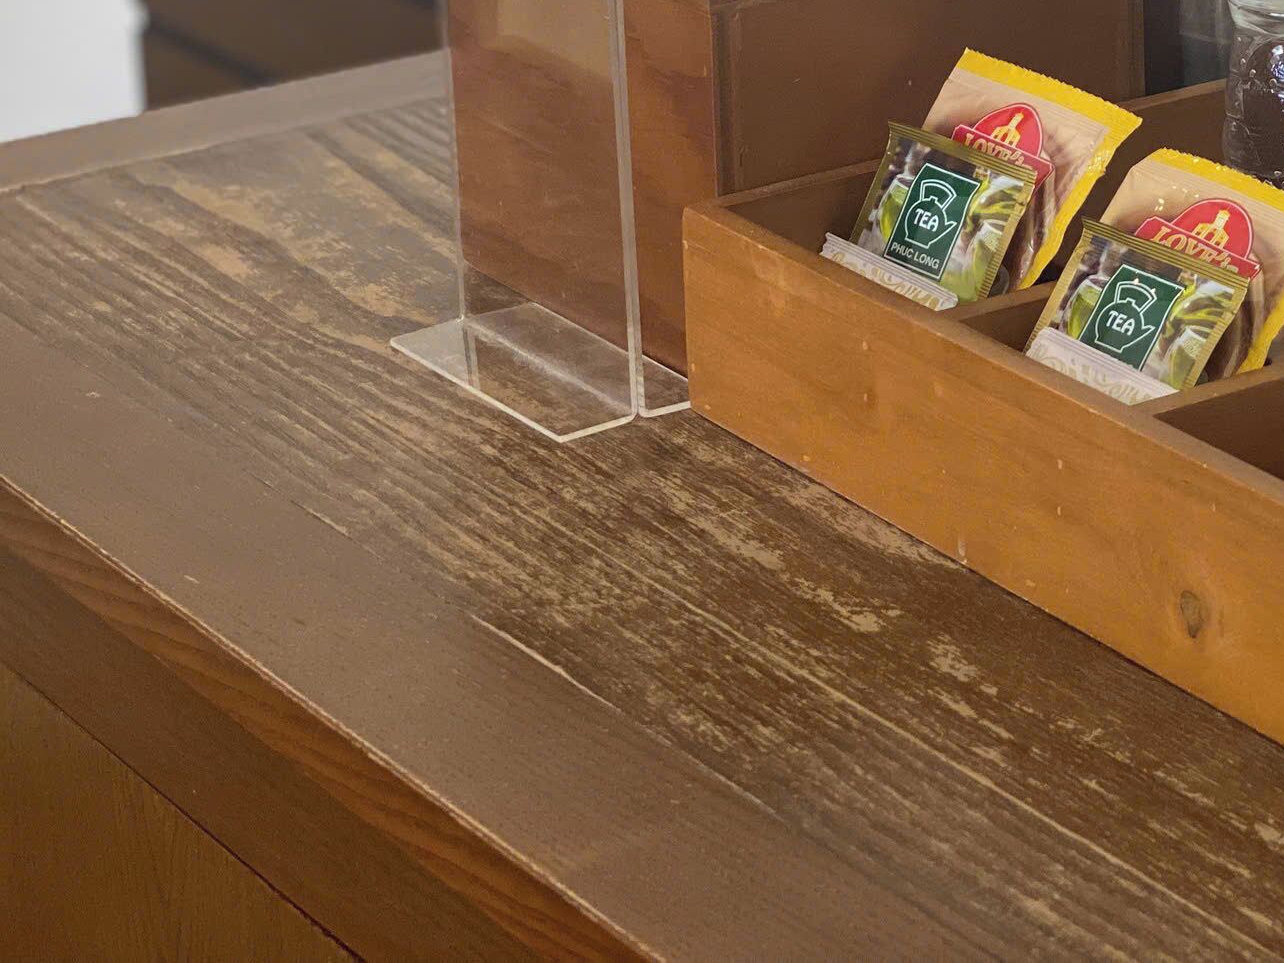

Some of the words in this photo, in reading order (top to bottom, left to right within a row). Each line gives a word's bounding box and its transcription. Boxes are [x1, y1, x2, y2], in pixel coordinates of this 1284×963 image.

[913, 208, 939, 232] TEA
[890, 241, 913, 259] PHUC
[914, 250, 940, 269] LONG
[1106, 310, 1136, 336] TEA
